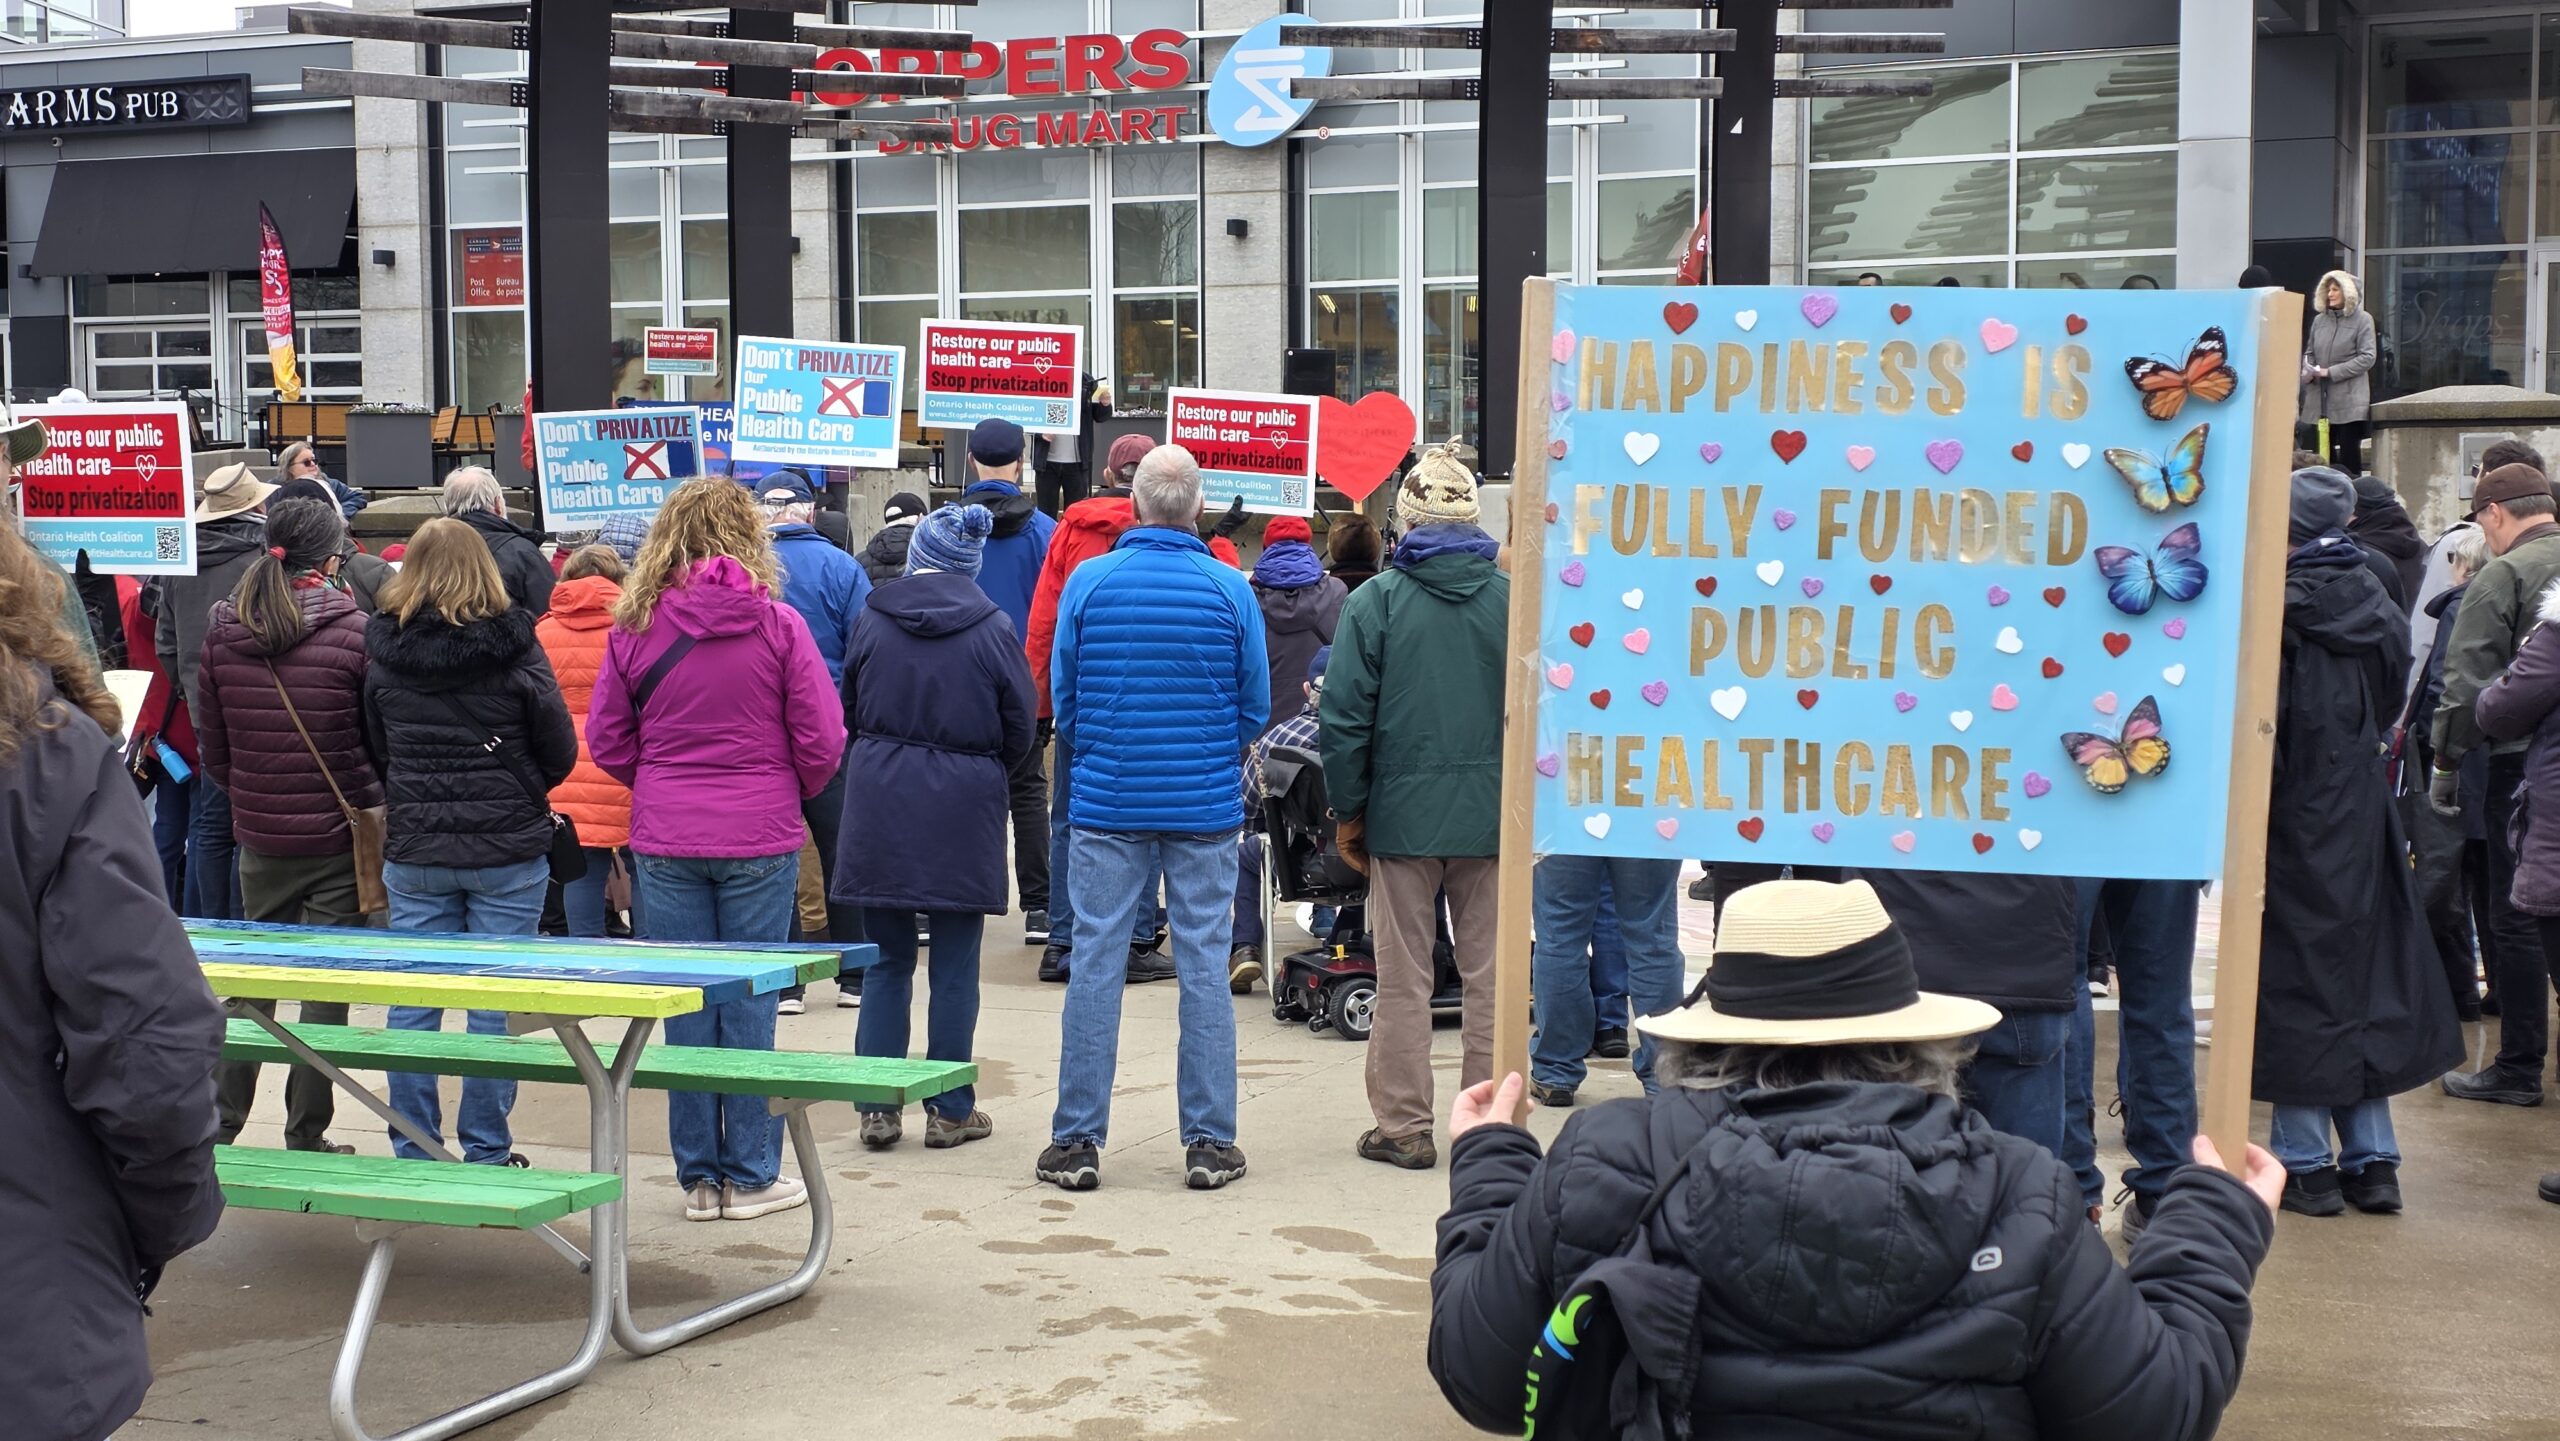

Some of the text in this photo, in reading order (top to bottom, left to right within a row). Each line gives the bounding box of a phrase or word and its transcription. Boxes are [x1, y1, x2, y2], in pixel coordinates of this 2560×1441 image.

[6, 87, 178, 126] ARMS PUB
[1037, 106, 1188, 145] MART
[470, 278, 485, 286] Post
[470, 287, 491, 297] Office
[496, 277, 519, 286] Bureau
[496, 287, 504, 296] de
[932, 332, 1061, 354] Restore our public
[797, 349, 895, 377] PRIVATIZE
[931, 351, 1012, 368] health care
[744, 370, 768, 384] Our
[931, 371, 1068, 394] Stop privatization
[1577, 336, 2092, 420] HAPPINESS IS
[742, 386, 804, 413] Public
[929, 400, 1035, 412] Ontario Health Coalition
[1177, 403, 1297, 428] Restore our public
[47, 423, 164, 452] store our public
[595, 415, 693, 441] PRIVATIZE
[741, 414, 855, 442] Health Care
[1176, 422, 1250, 443] health care
[545, 445, 569, 458] Our
[1211, 448, 1303, 471] privatization
[26, 453, 111, 476] health care
[548, 459, 609, 483] Public
[550, 483, 664, 509] Health Care
[1206, 478, 1233, 487] Health
[1235, 480, 1271, 491] Coalition
[28, 484, 178, 516] Stop privatization
[1572, 482, 2089, 566] FULLY FUNDED
[29, 531, 143, 543] Ontario Health Coalition
[1689, 604, 1956, 680] PUBLIC
[1567, 731, 2012, 822] HEALTHCARE
